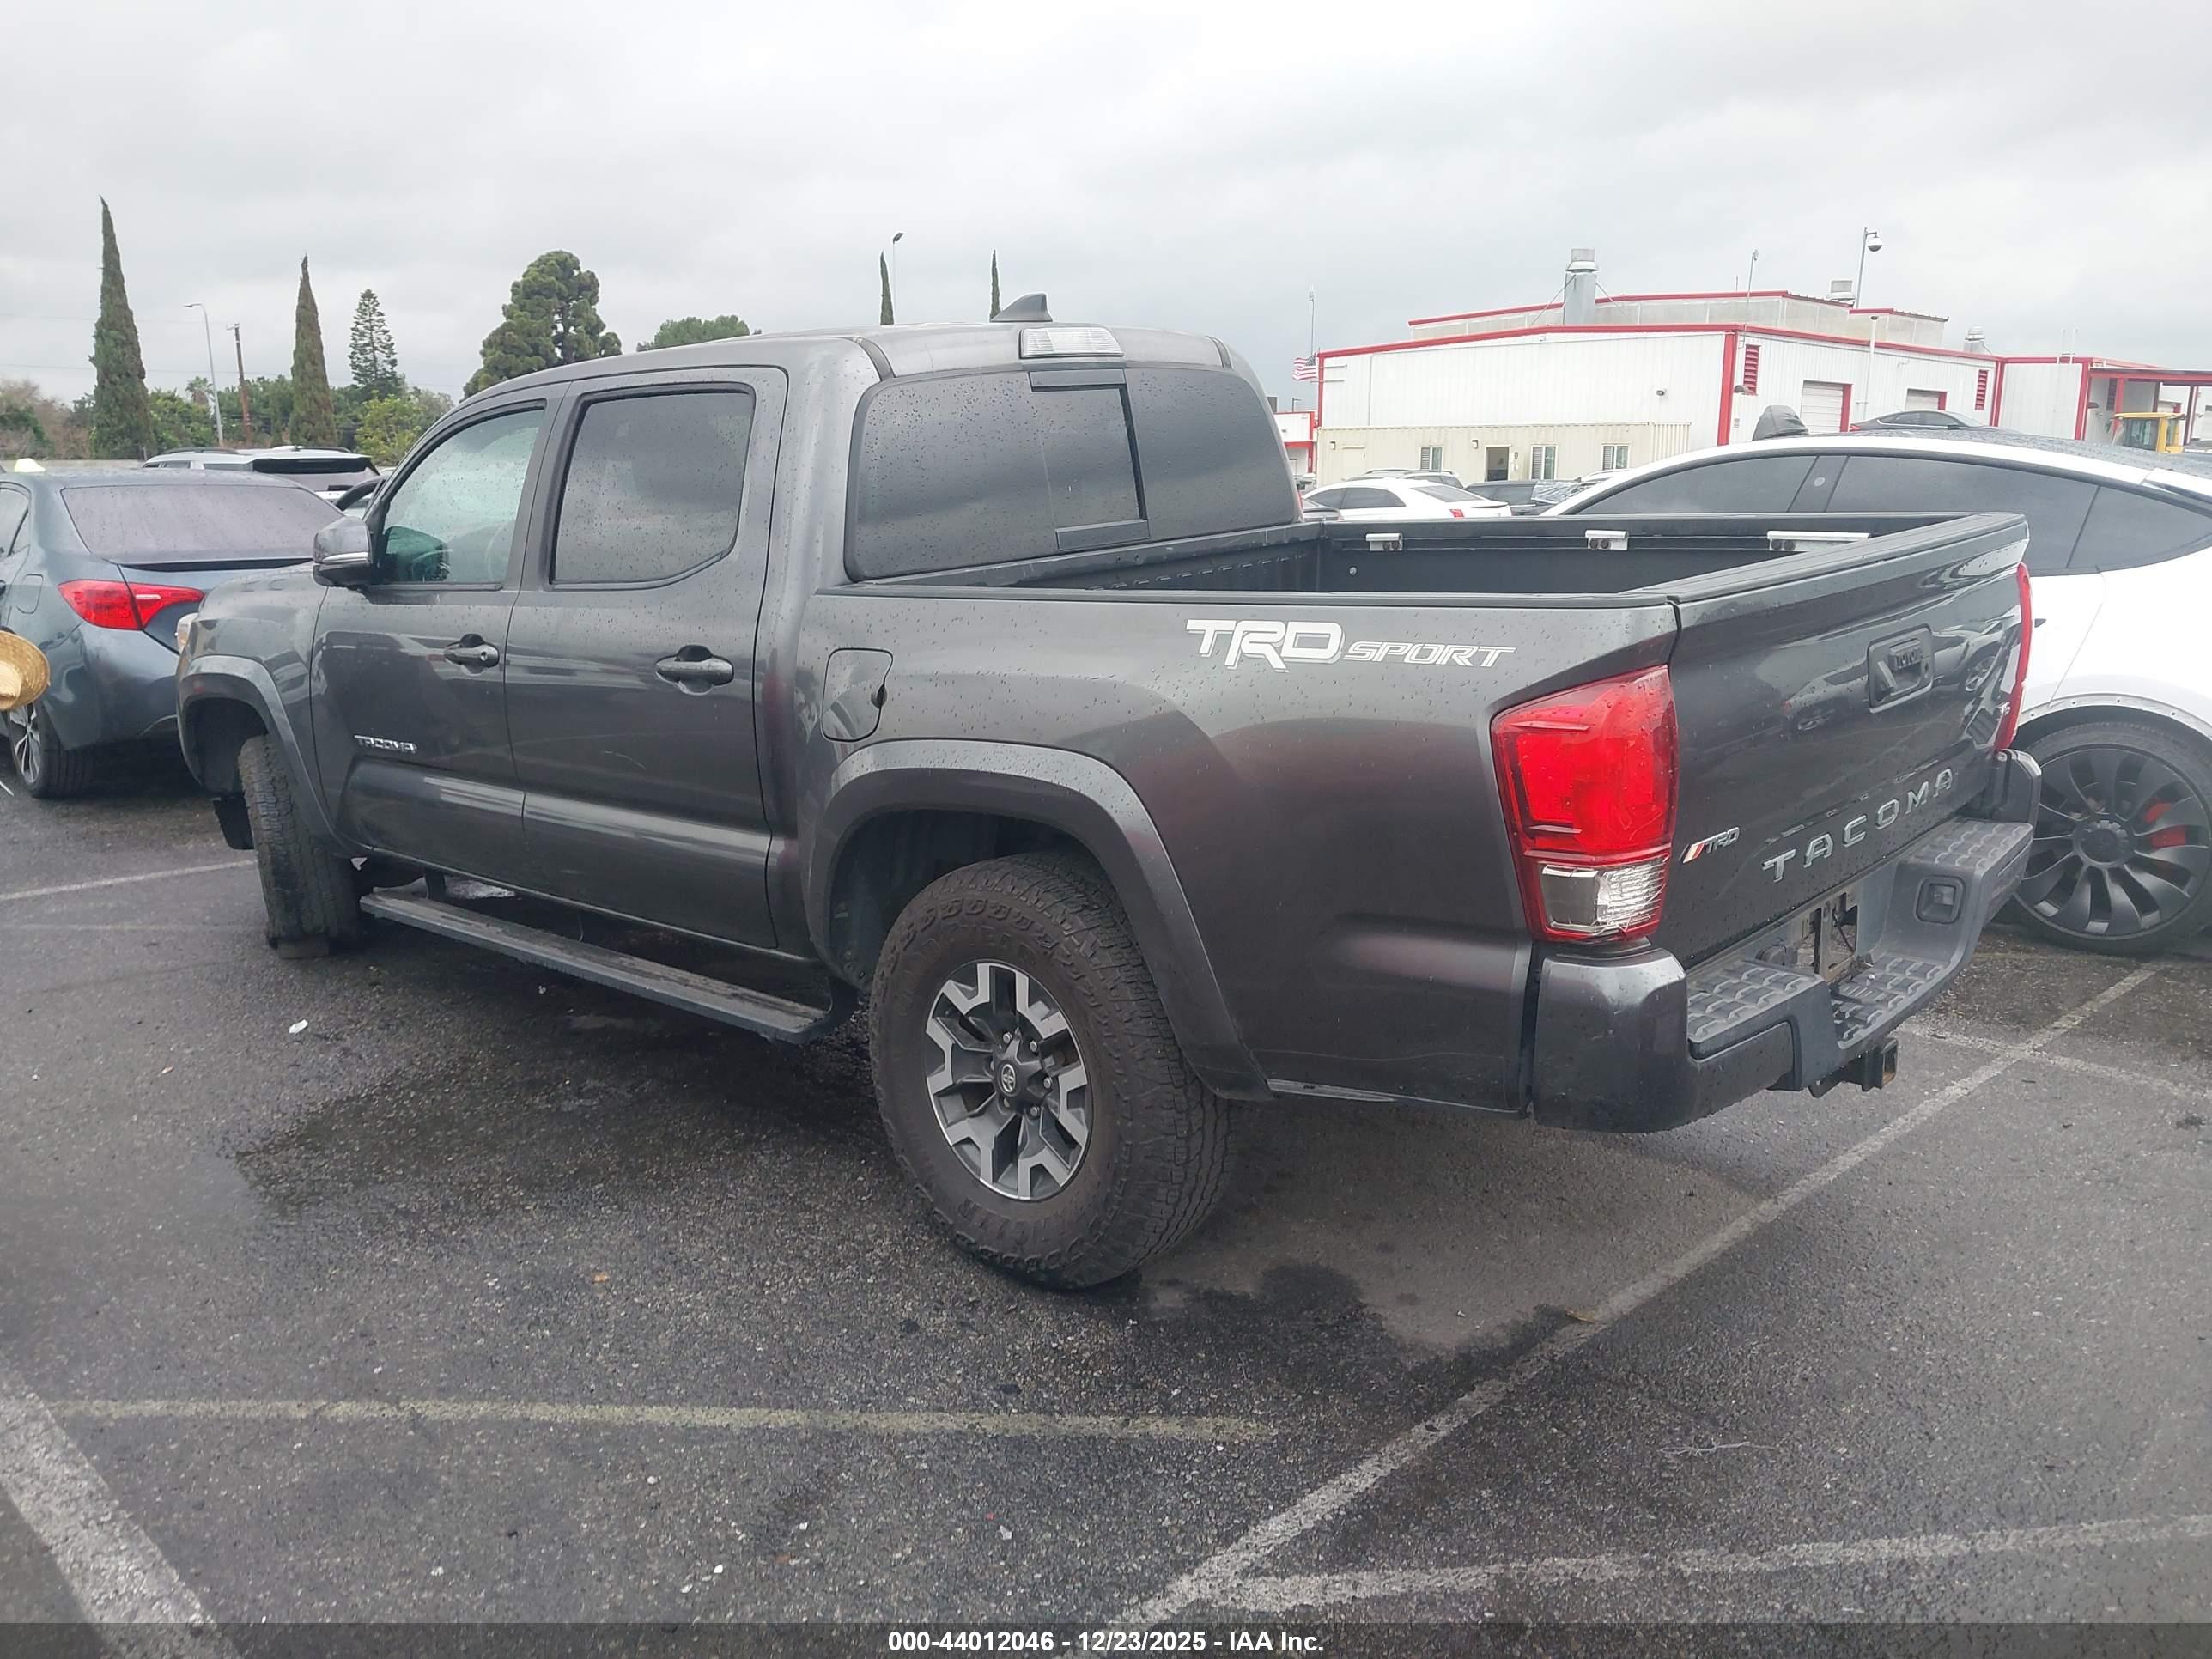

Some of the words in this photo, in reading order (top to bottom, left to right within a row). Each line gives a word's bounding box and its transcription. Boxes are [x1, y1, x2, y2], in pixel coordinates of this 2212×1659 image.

[1186, 620, 1346, 672] TRD
[1344, 641, 1516, 667] SPORT
[354, 734, 418, 754] TACOMA
[1703, 827, 1741, 854] TRD
[1762, 769, 1954, 883] TACOMA
